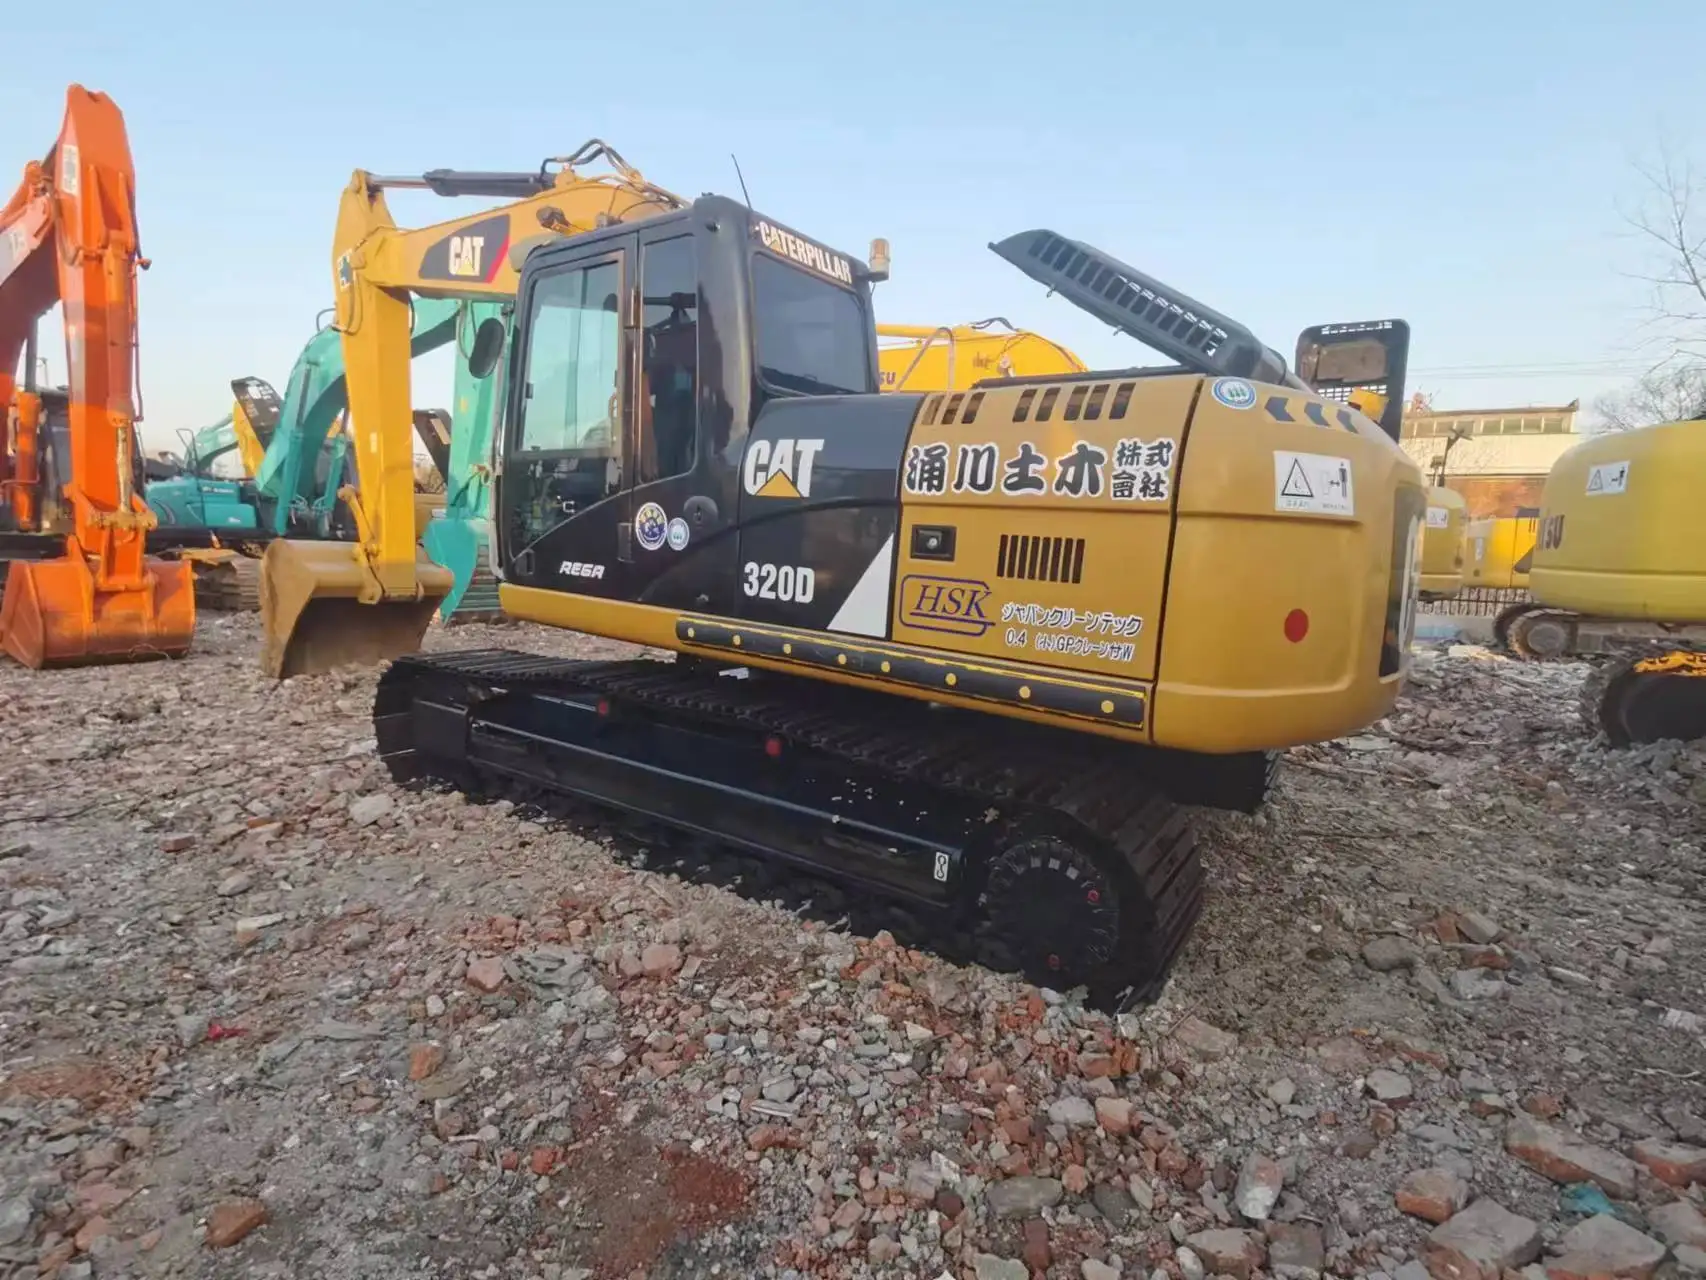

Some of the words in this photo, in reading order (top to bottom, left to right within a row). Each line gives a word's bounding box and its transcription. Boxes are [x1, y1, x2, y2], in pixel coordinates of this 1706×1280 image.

[448, 236, 484, 276] CAT
[759, 220, 852, 285] CATERPILLAR
[744, 439, 825, 498] CAT
[743, 561, 815, 604] 320D
[914, 584, 992, 618] HSK
[1005, 628, 1027, 647] 0.4
